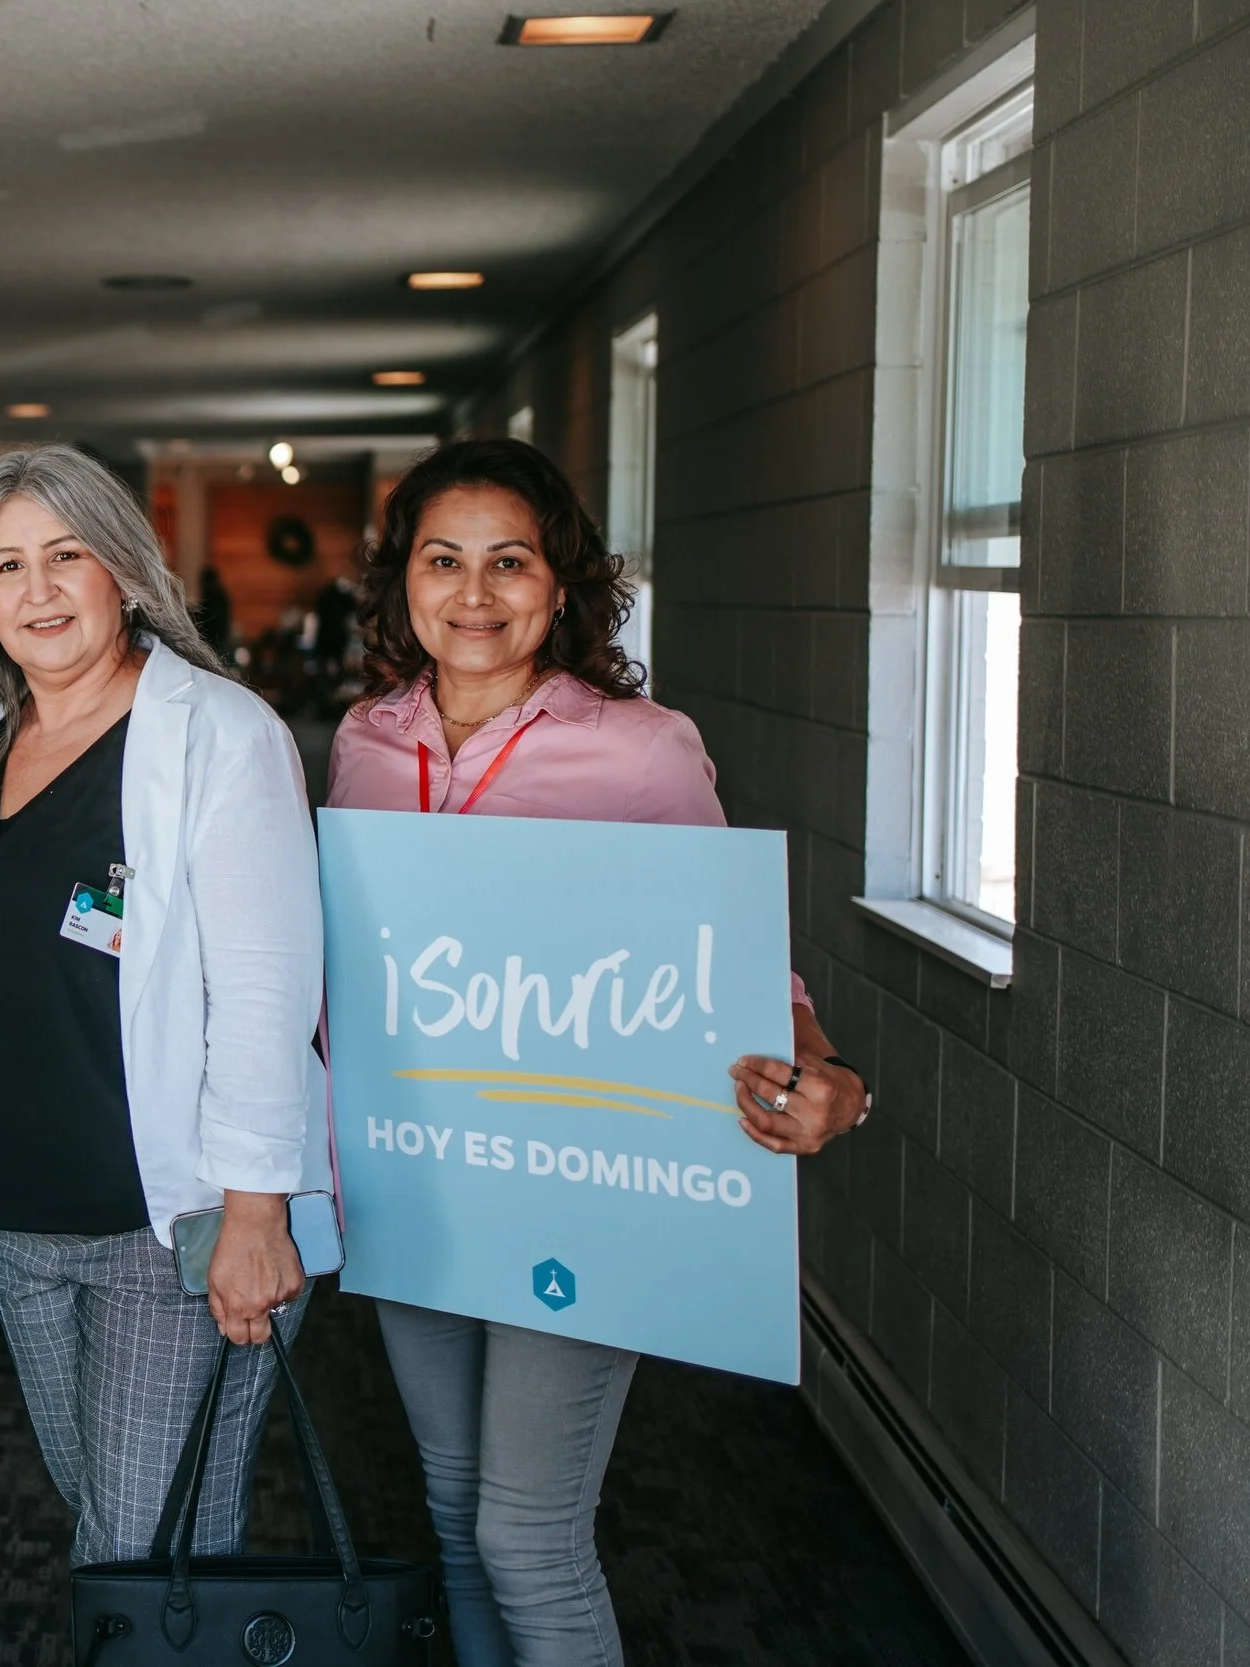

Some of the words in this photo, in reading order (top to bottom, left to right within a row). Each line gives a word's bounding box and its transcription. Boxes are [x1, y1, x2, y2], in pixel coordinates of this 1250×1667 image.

[366, 1116, 453, 1160] HOY
[465, 1131, 515, 1170] ES
[528, 1141, 752, 1207] DOMINGO
